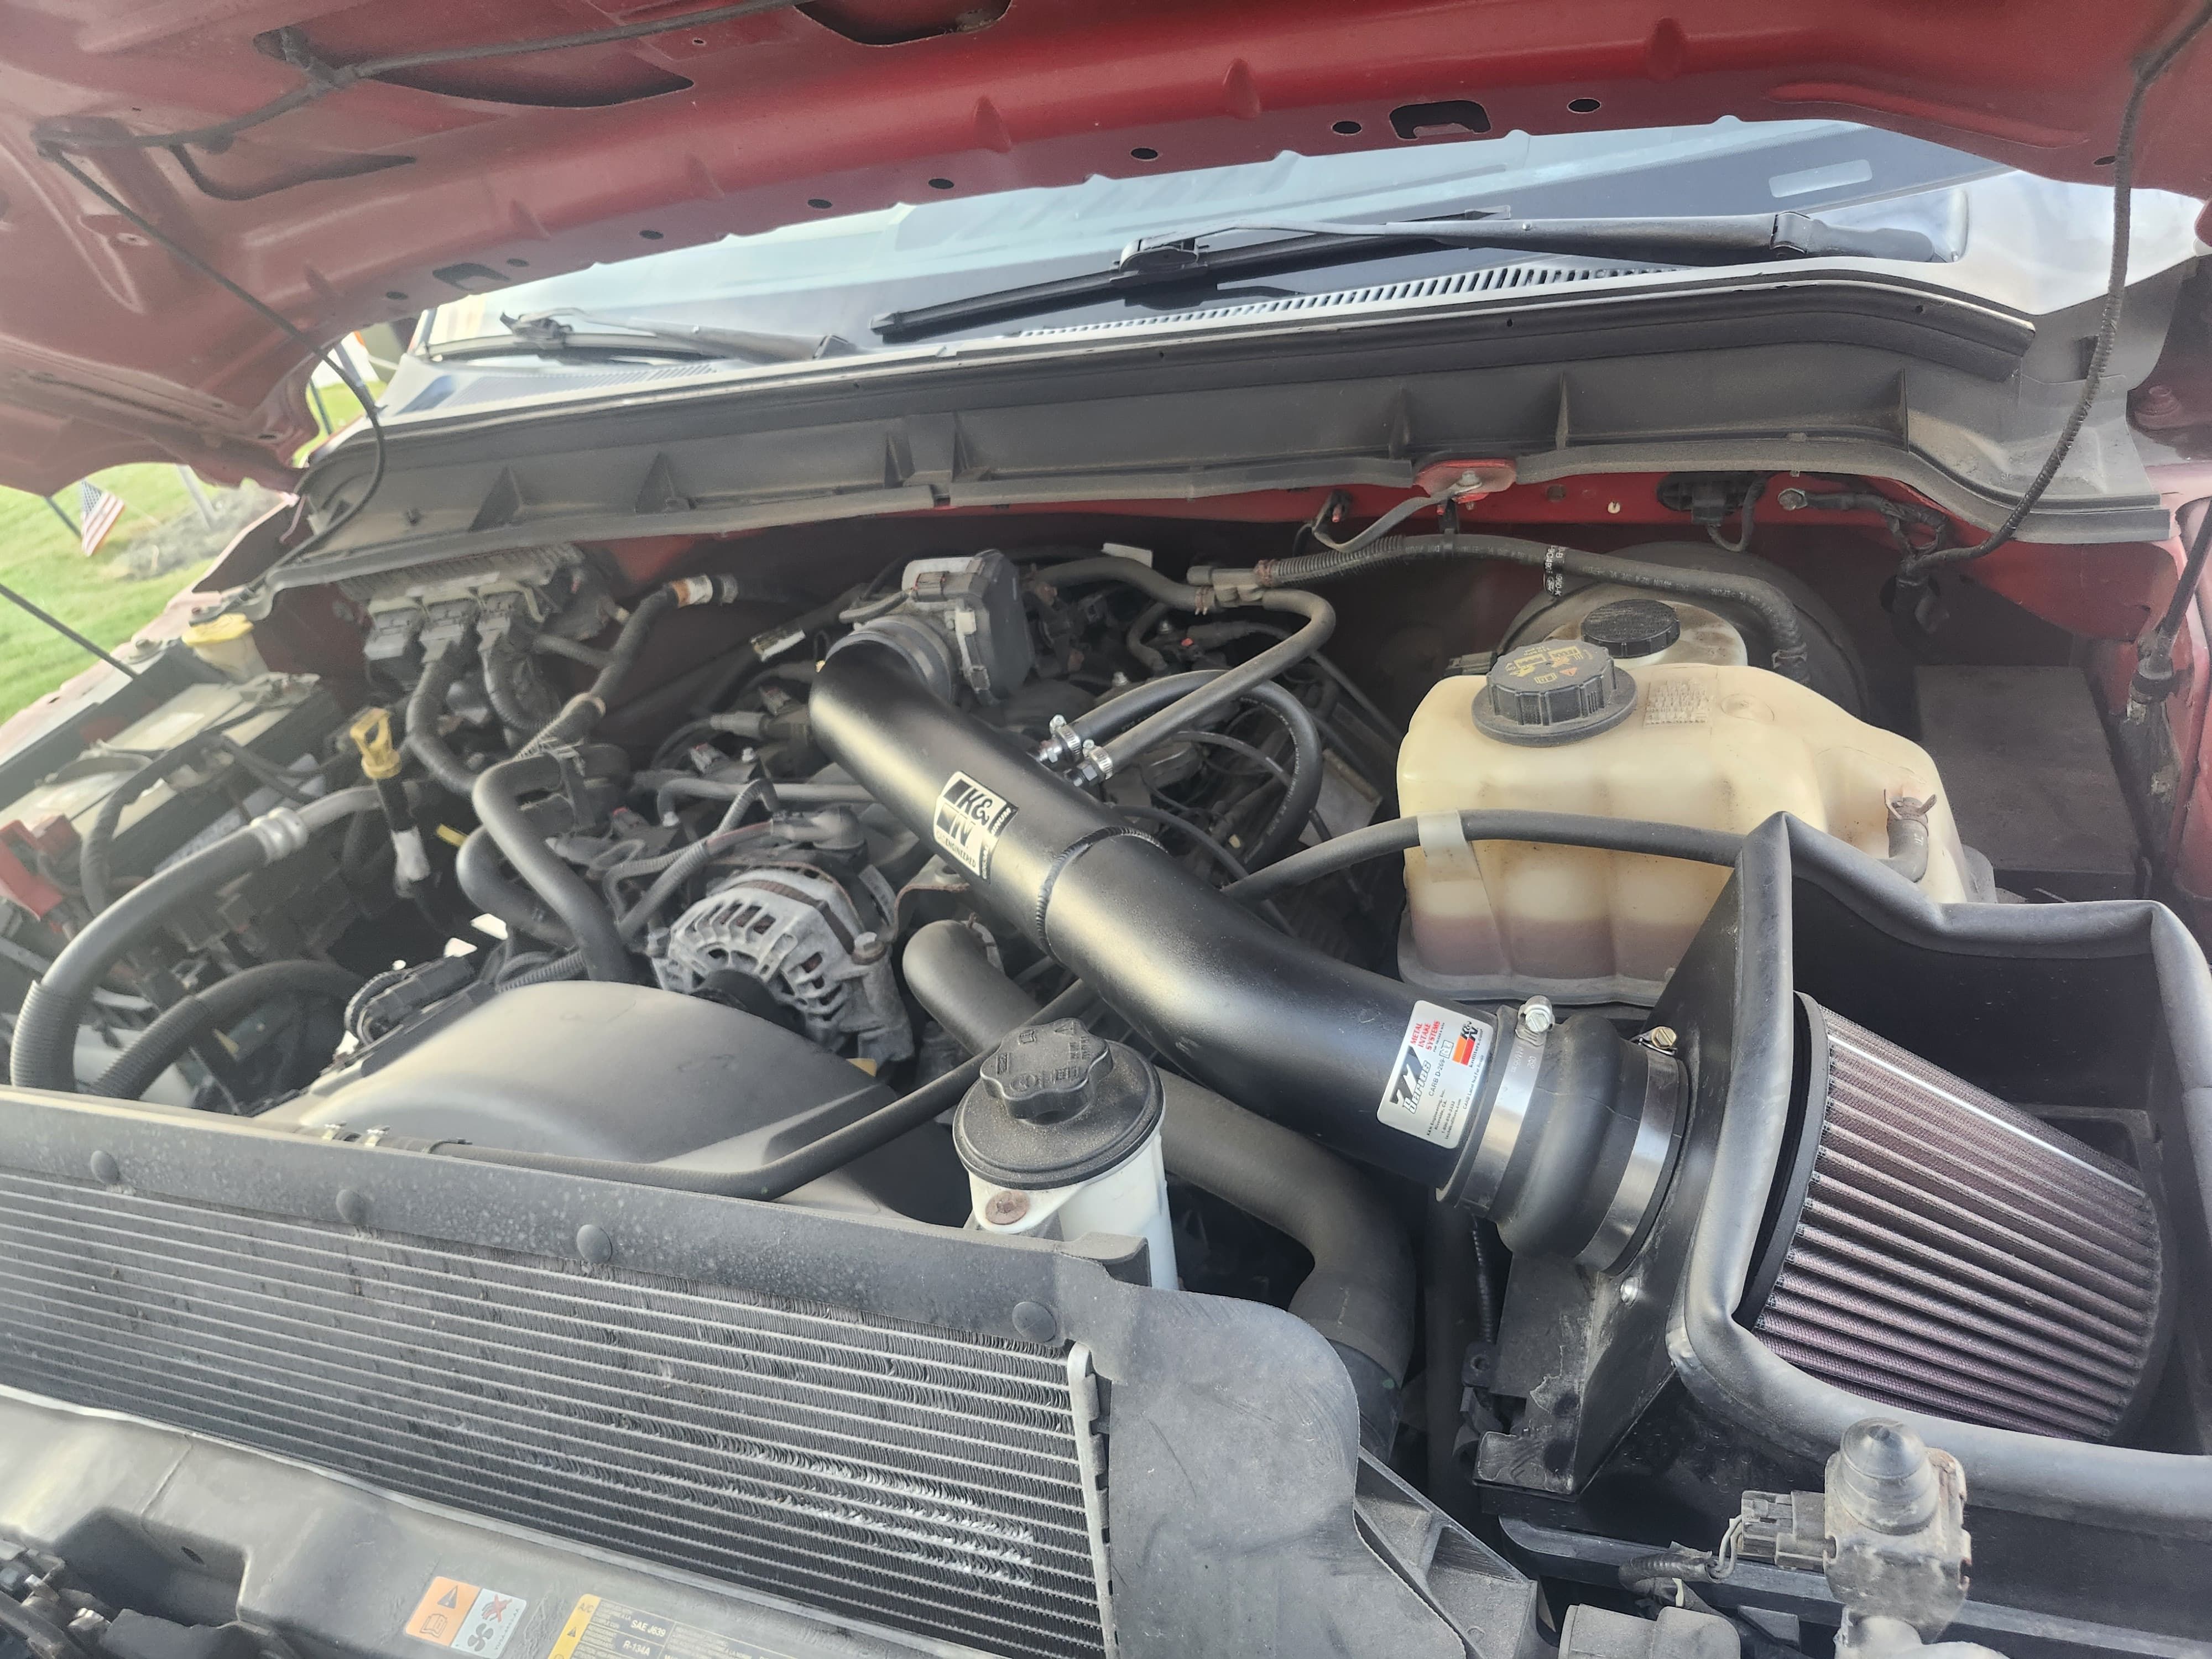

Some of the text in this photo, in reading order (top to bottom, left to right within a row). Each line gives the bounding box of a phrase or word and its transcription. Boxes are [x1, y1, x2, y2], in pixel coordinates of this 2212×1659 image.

[1410, 1022, 1423, 1045] METAL
[1418, 1023, 1431, 1048] INTAKE
[1426, 1020, 1441, 1051] SYSTEMS
[1429, 1078, 1439, 1097] CARB
[578, 1603, 594, 1613] A/C
[631, 1620, 666, 1637] SAE J639
[622, 1640, 651, 1656] R-134A
